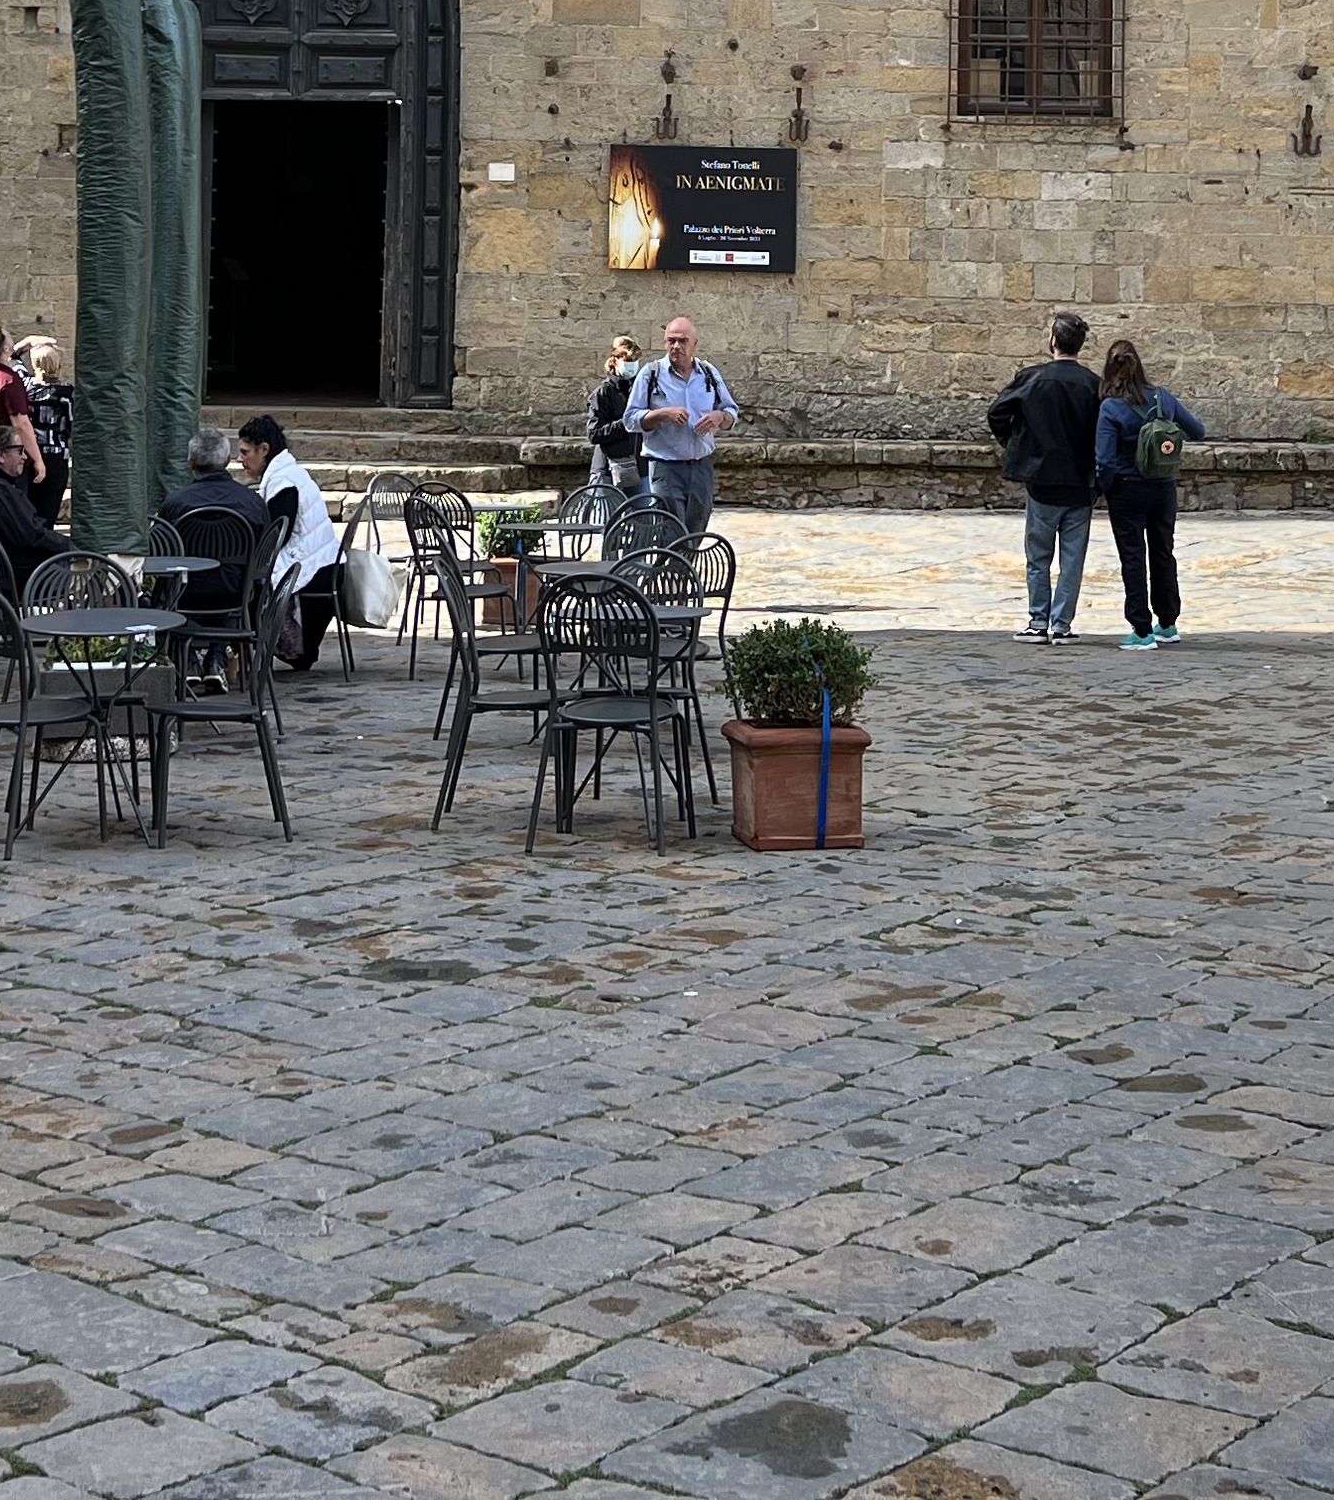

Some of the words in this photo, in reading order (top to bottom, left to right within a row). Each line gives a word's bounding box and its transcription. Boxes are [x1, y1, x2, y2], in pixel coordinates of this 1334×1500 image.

[701, 160, 731, 170] Stefano
[732, 160, 760, 170] Tonelli
[676, 174, 692, 190] IN
[695, 175, 785, 191] AENIGMATE
[683, 224, 710, 234] Palazzo
[711, 225, 723, 234] dei
[724, 225, 745, 235] Priori
[746, 226, 776, 235] Volterra
